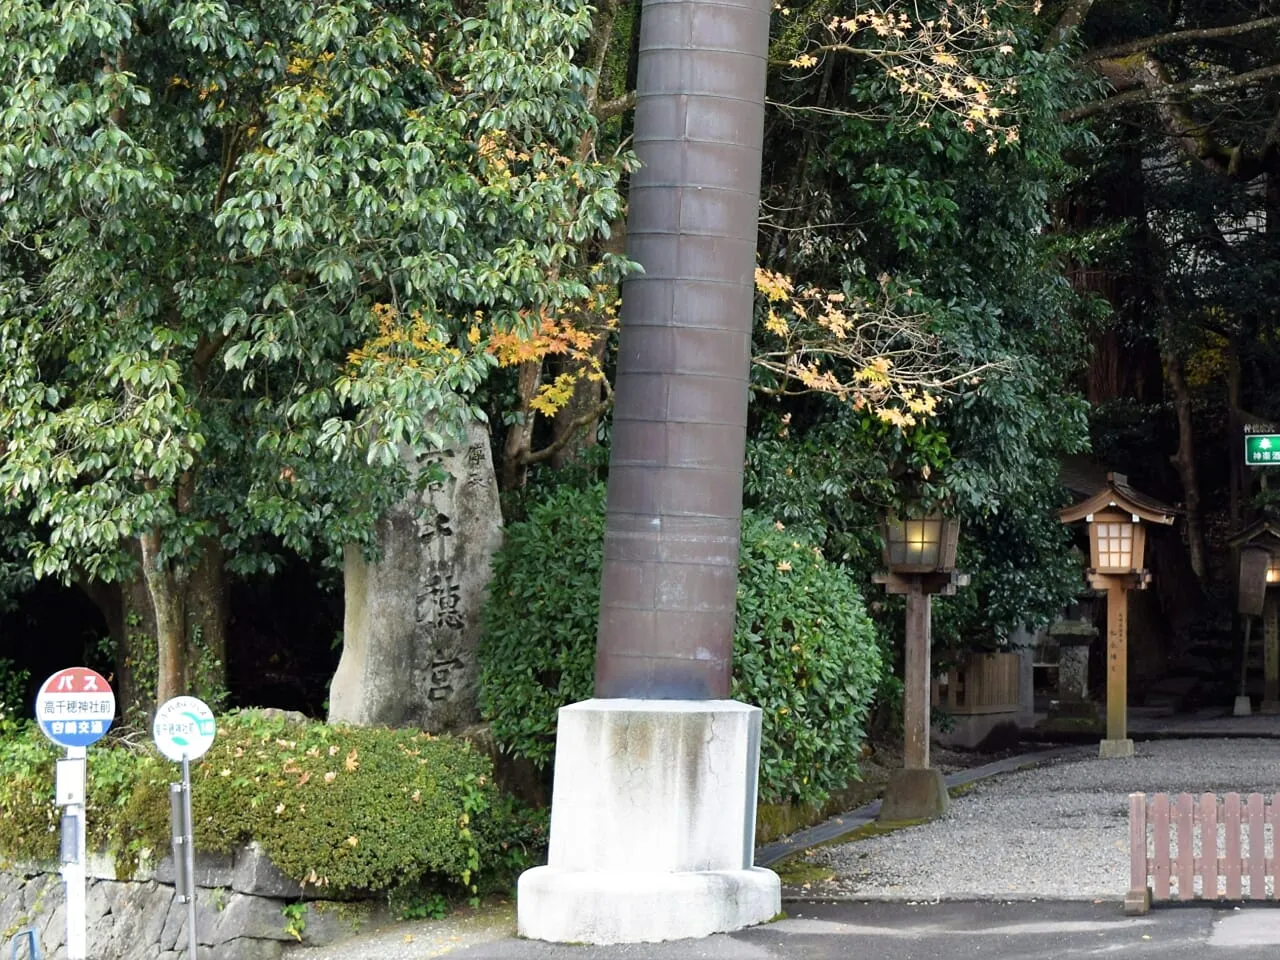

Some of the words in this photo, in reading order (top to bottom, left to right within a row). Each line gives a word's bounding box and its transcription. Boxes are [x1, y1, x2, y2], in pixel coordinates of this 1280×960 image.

[57, 675, 98, 691] バス
[44, 700, 111, 714] 高千穂神社前
